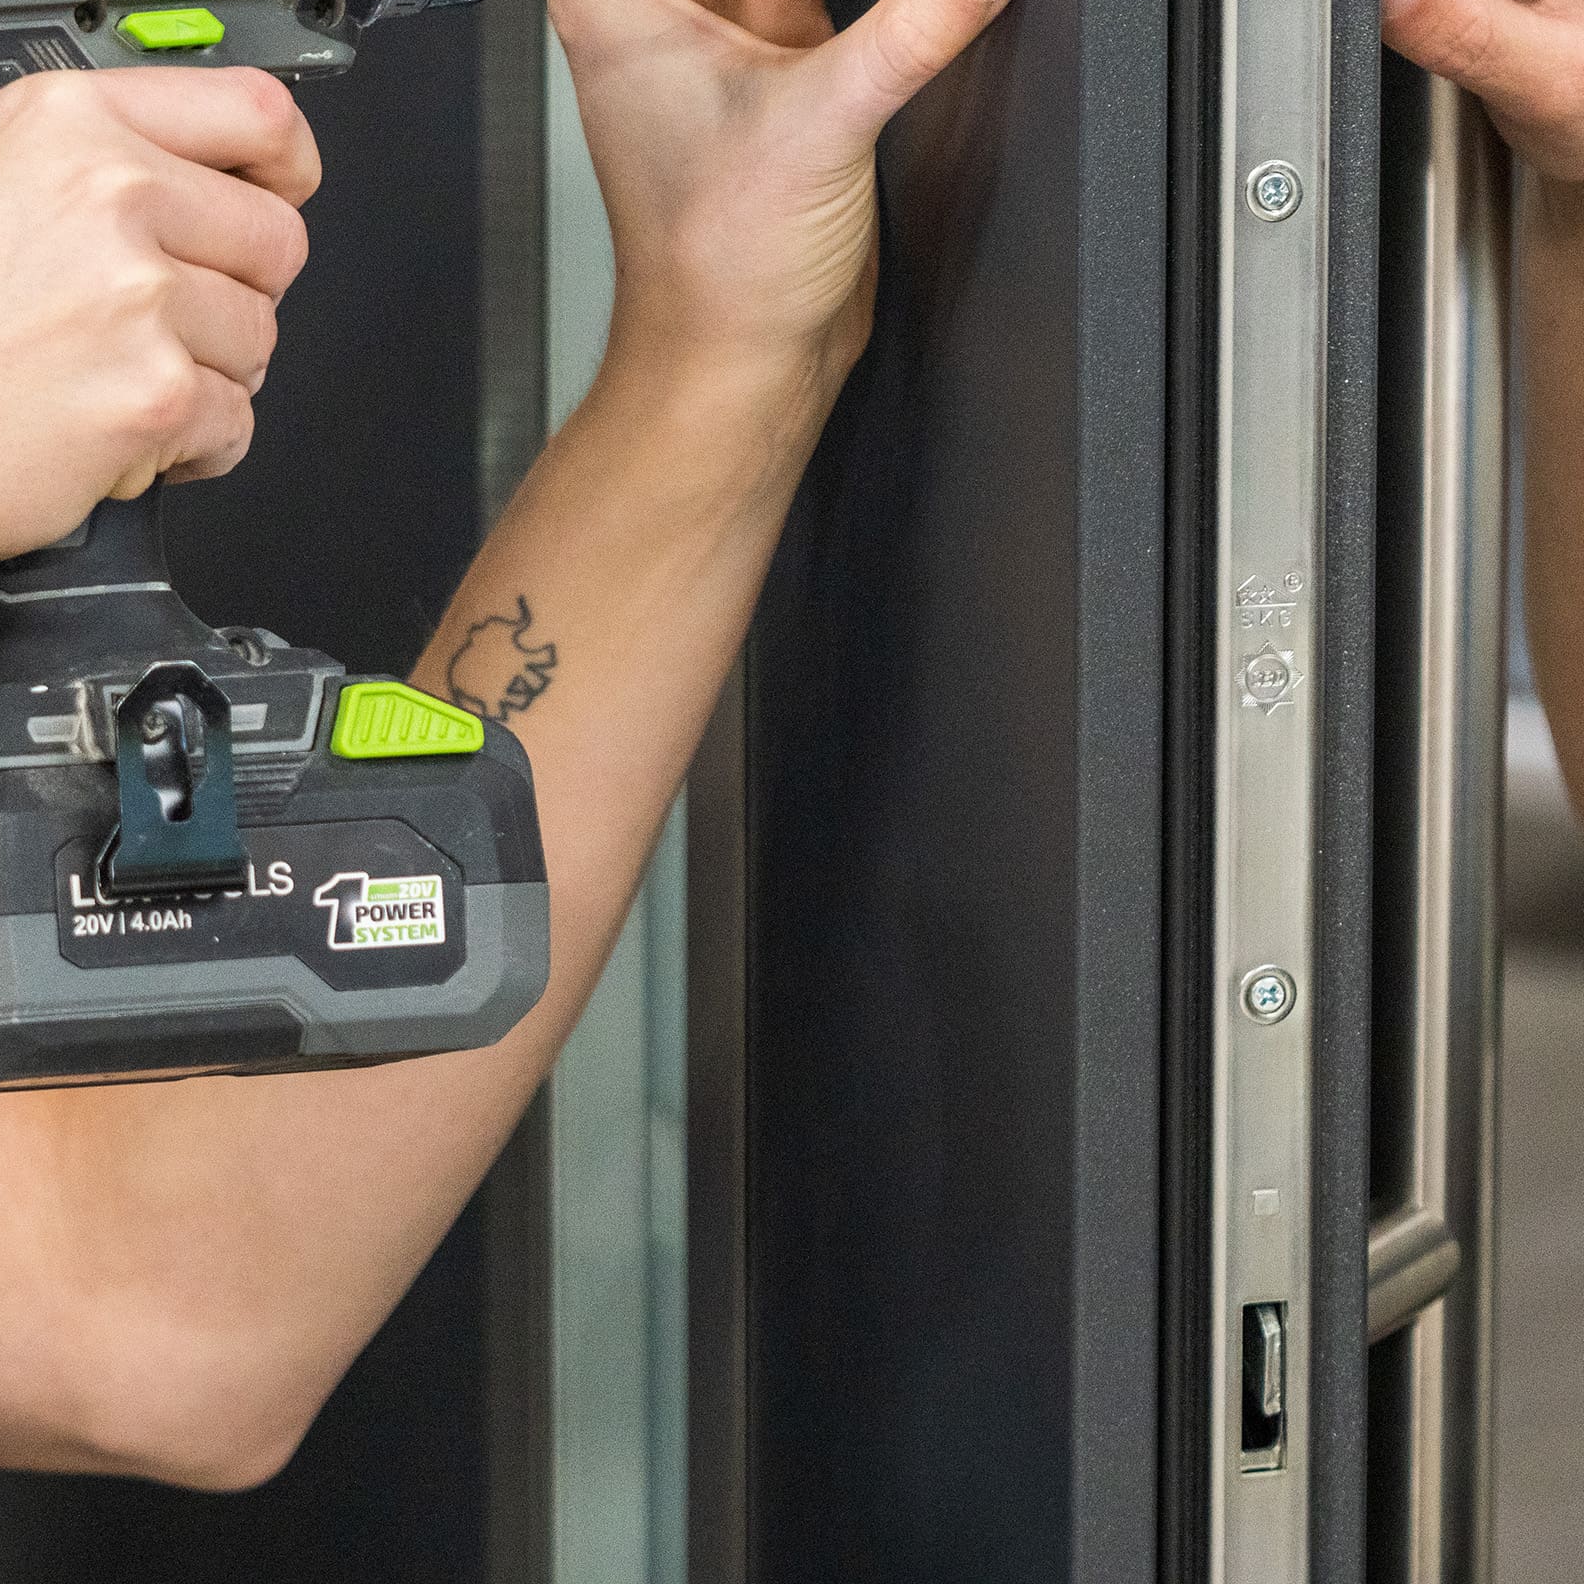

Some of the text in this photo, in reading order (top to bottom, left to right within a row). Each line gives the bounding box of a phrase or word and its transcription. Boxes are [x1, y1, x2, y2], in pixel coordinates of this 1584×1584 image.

[399, 881, 435, 900] 20V
[73, 913, 114, 936] 20V
[130, 908, 193, 932] 4.0Ah
[355, 901, 437, 924] POWER
[356, 922, 438, 944] SYSTEM
